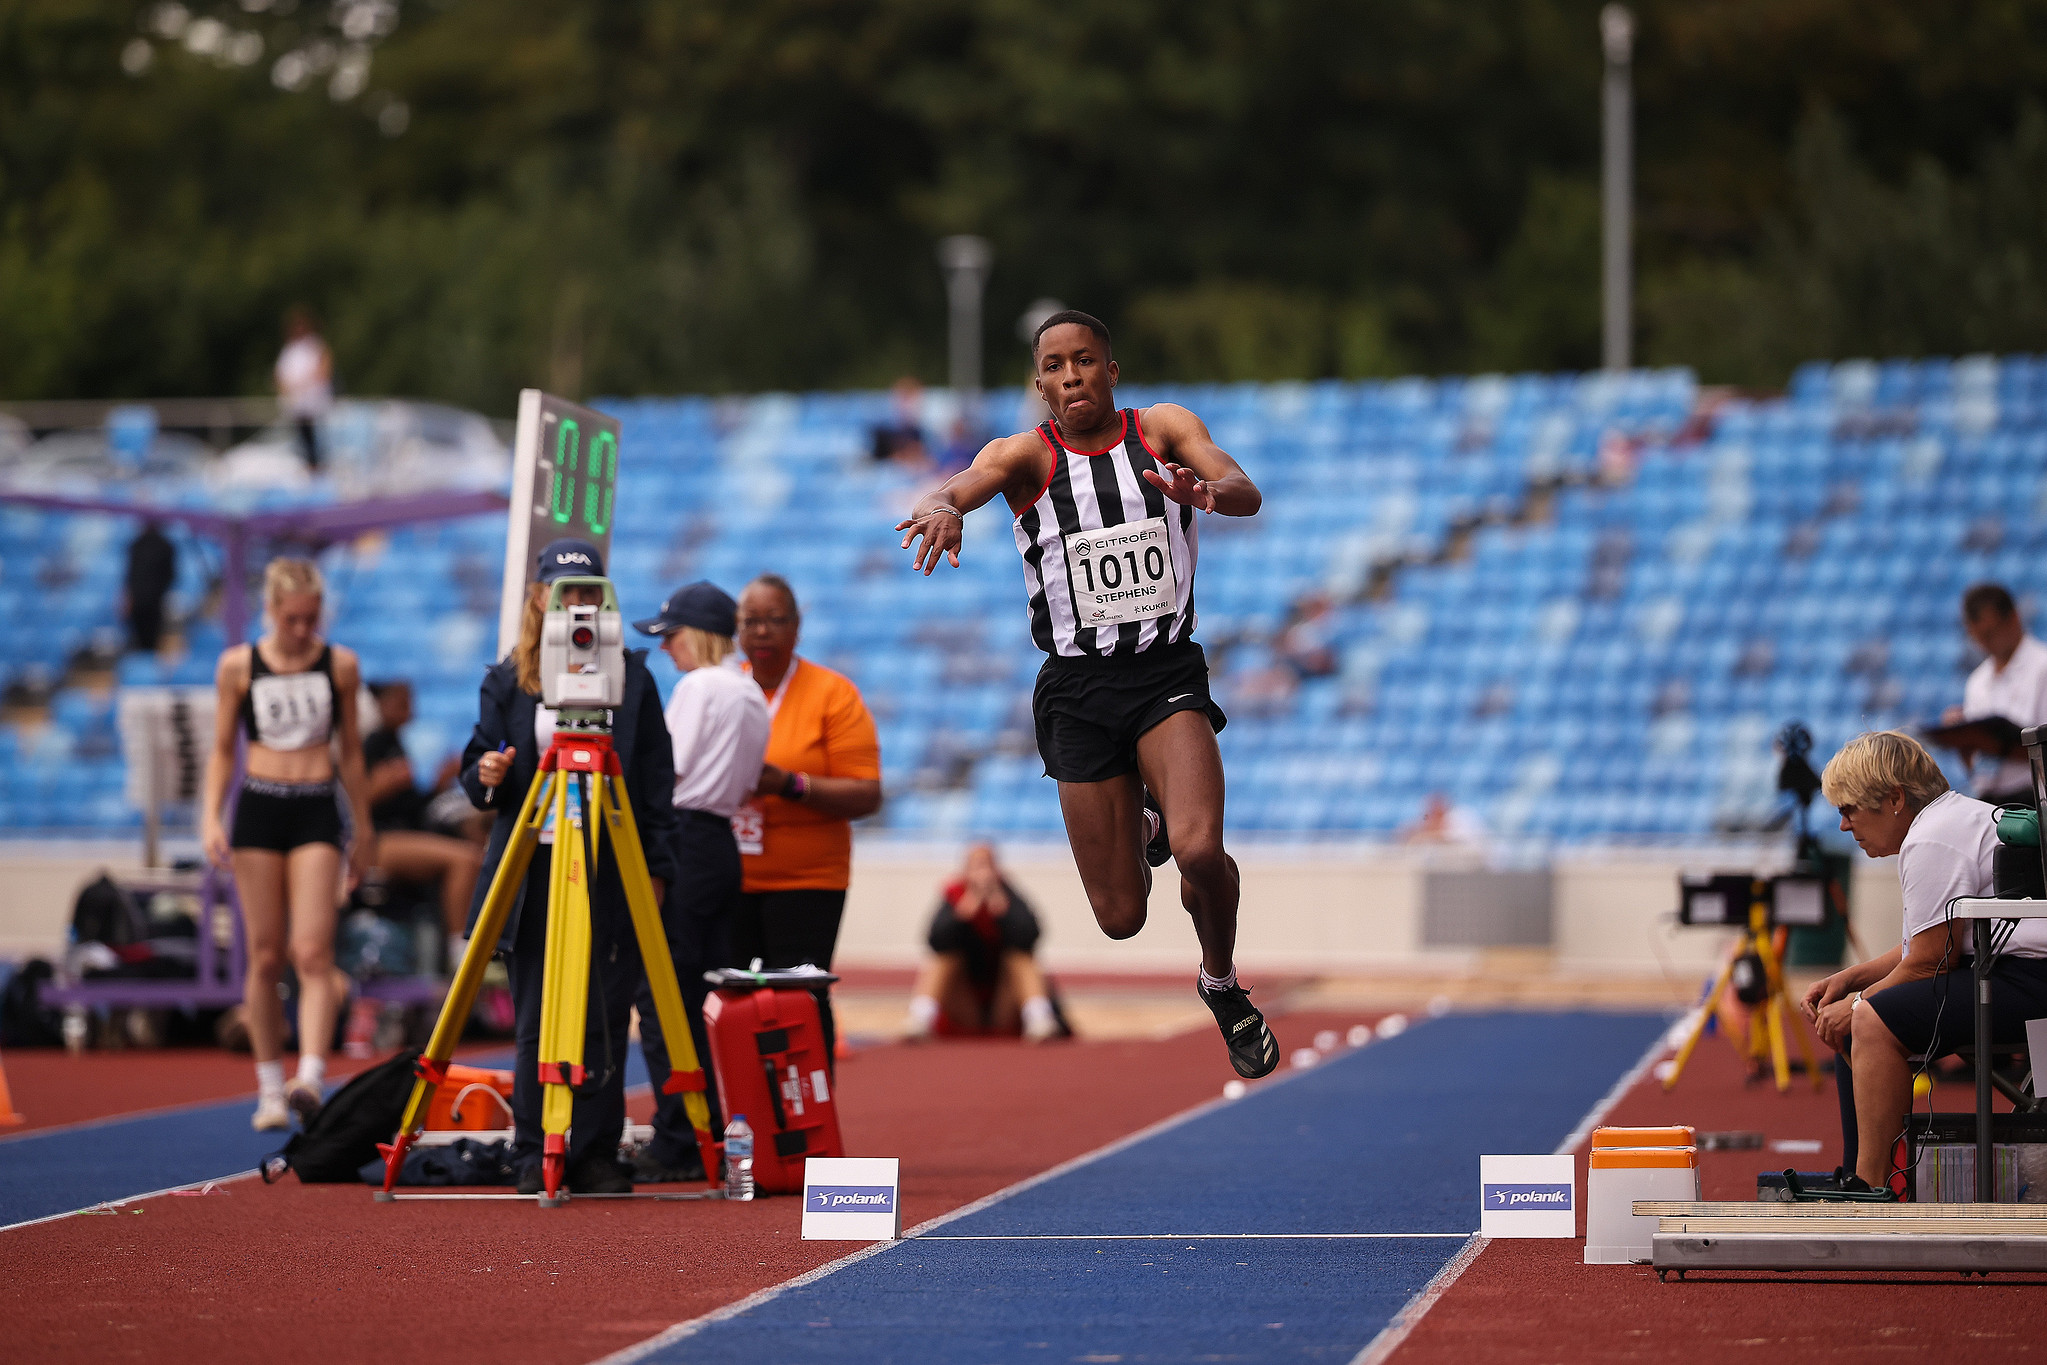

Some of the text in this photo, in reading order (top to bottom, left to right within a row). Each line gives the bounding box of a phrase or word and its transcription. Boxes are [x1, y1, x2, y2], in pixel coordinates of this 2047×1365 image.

[1095, 530, 1158, 549] CITROËN
[1079, 546, 1165, 592] 1010
[1095, 585, 1157, 604] STEPHENS
[1141, 601, 1168, 613] KUKRI
[1232, 1013, 1259, 1035] ADIZERO
[831, 1192, 889, 1207] polanik
[1509, 1190, 1566, 1205] polanik
